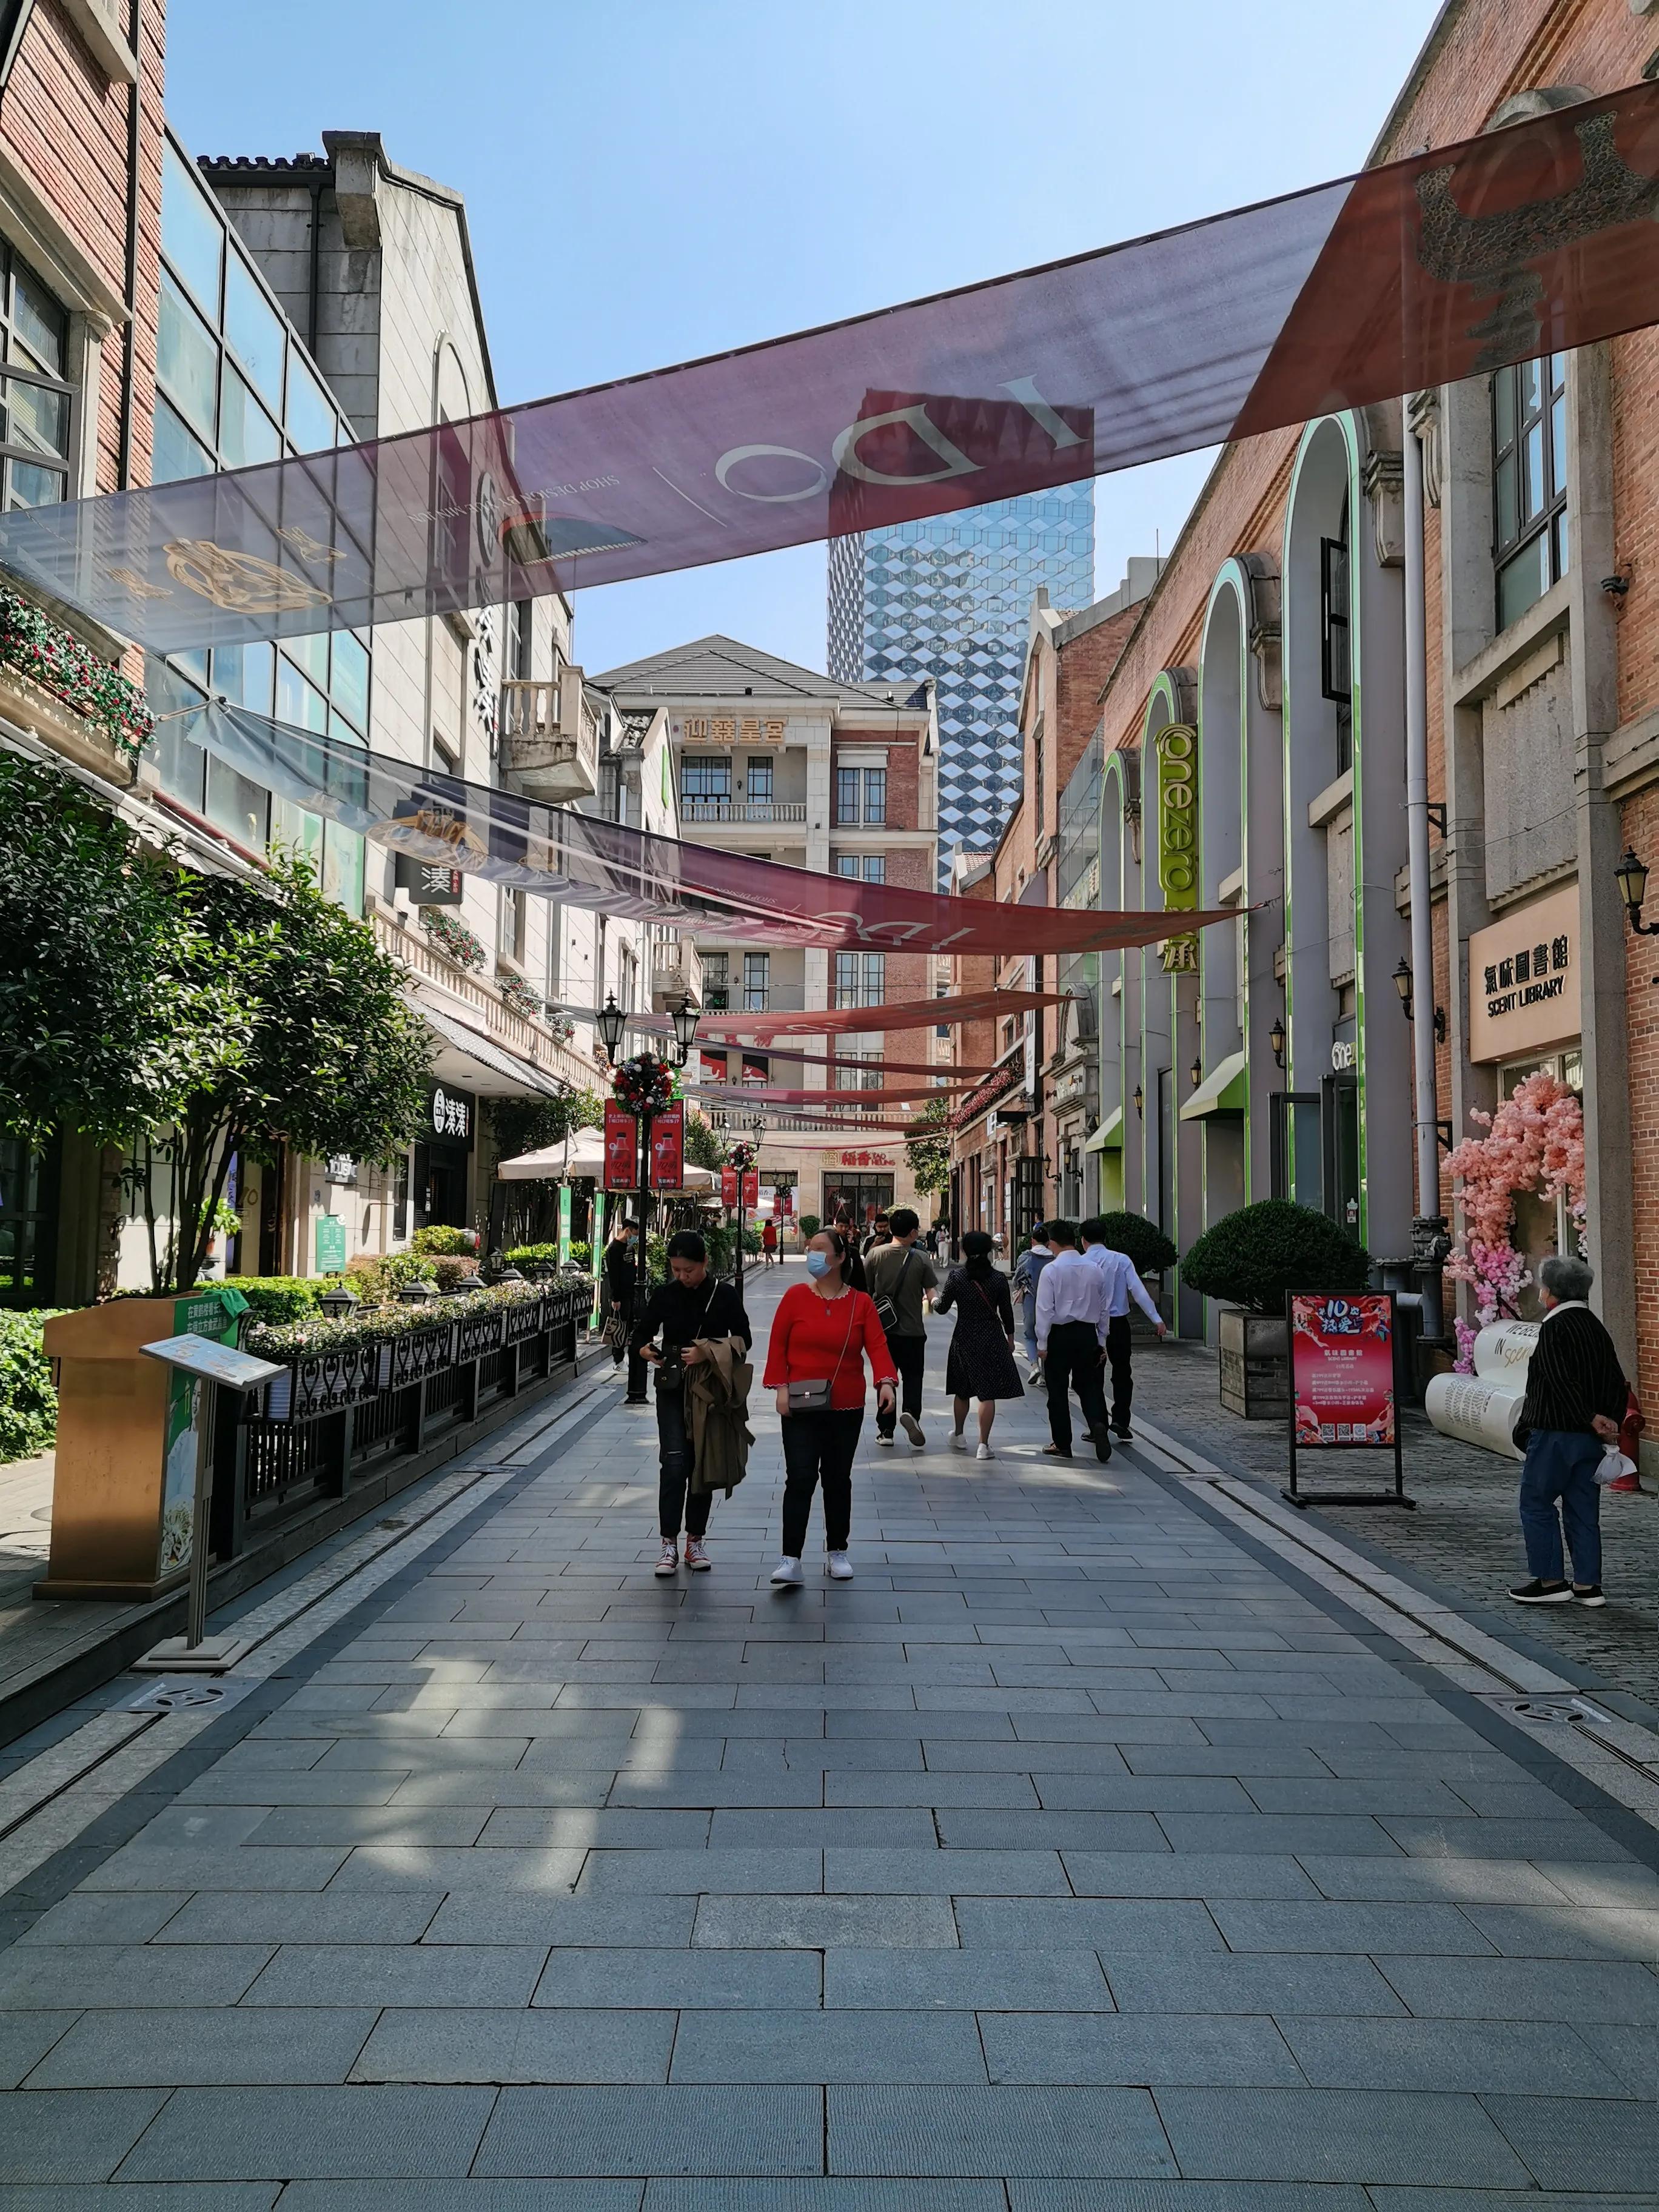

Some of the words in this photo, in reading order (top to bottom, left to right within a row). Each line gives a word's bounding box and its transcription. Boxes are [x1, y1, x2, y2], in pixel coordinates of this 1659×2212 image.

[580, 475, 620, 492] SHOP
[522, 483, 578, 503] DESIGN
[1488, 992, 1517, 1018] SCENT
[1519, 974, 1565, 1007] LIBRARY
[1495, 1338, 1506, 1355] IN
